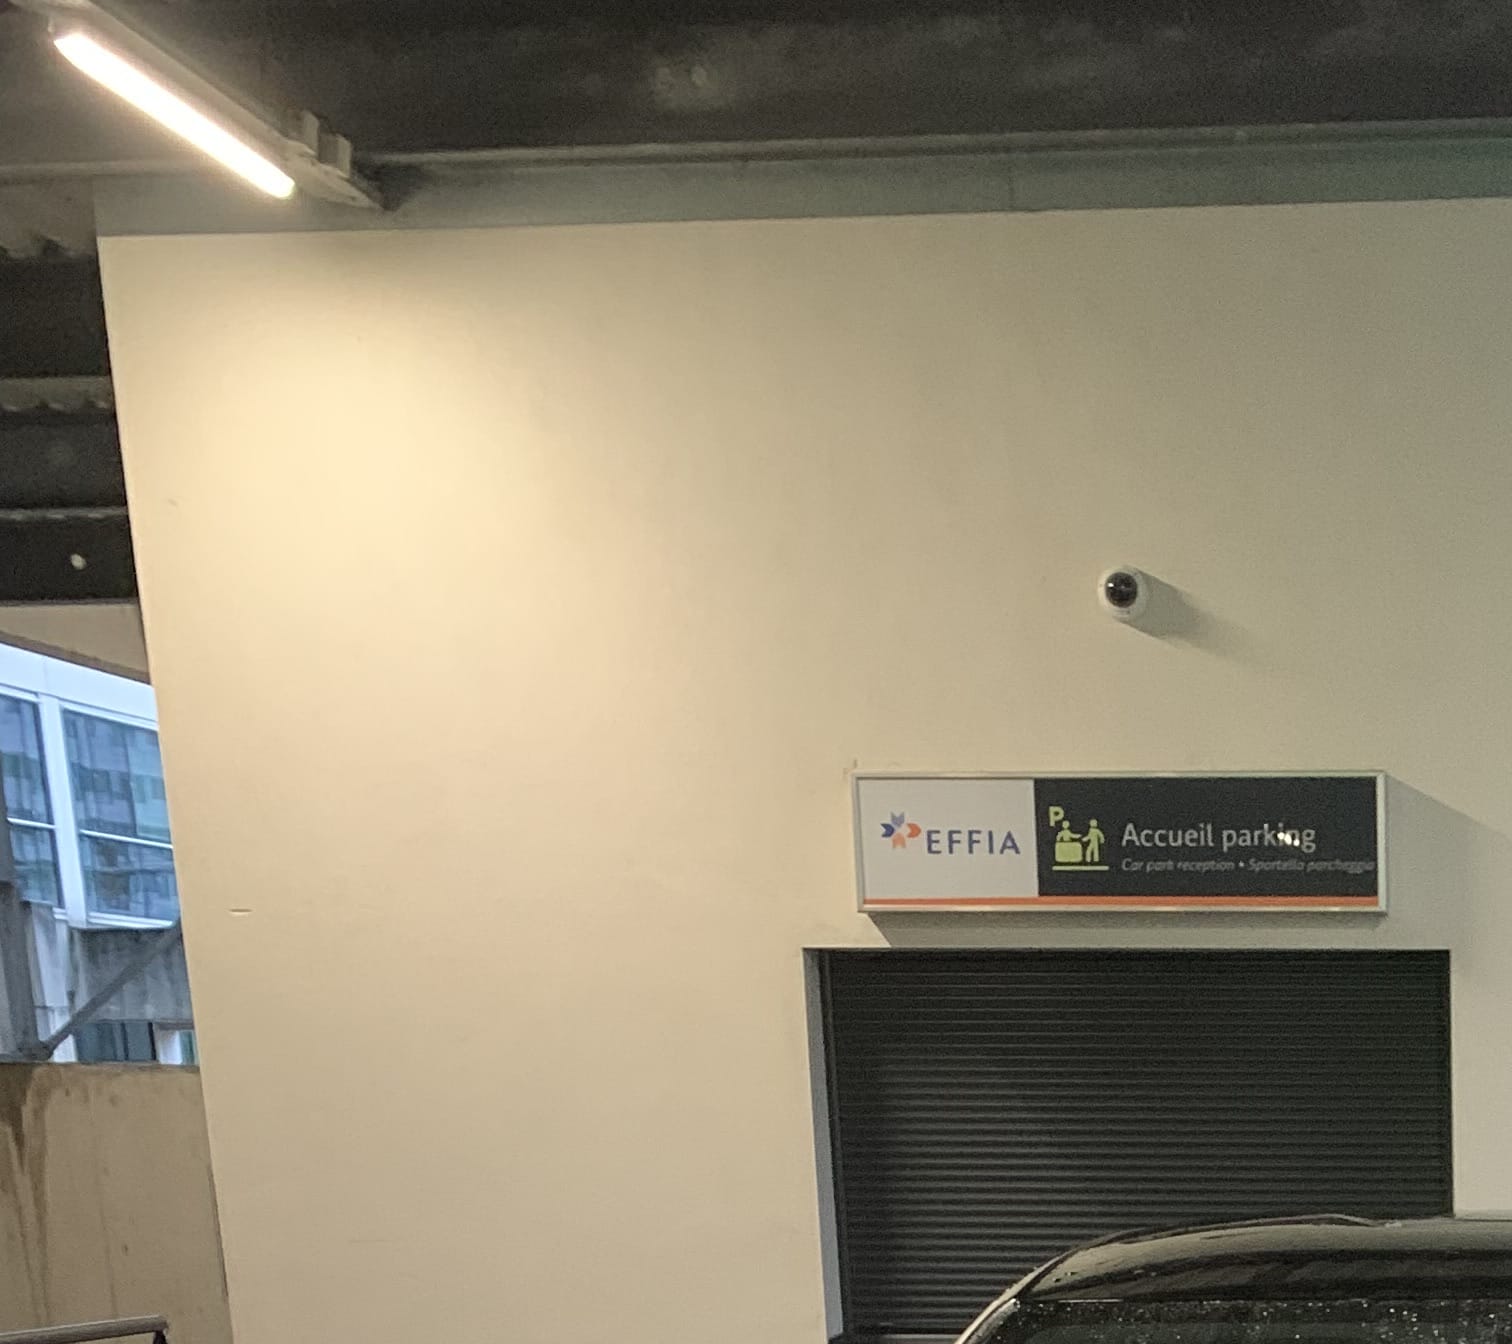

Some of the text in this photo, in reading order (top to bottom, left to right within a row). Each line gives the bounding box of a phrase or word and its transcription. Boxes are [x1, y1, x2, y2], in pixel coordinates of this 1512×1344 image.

[1048, 806, 1065, 827] P
[926, 829, 1021, 855] EFFIA
[1121, 822, 1214, 848] Accueil
